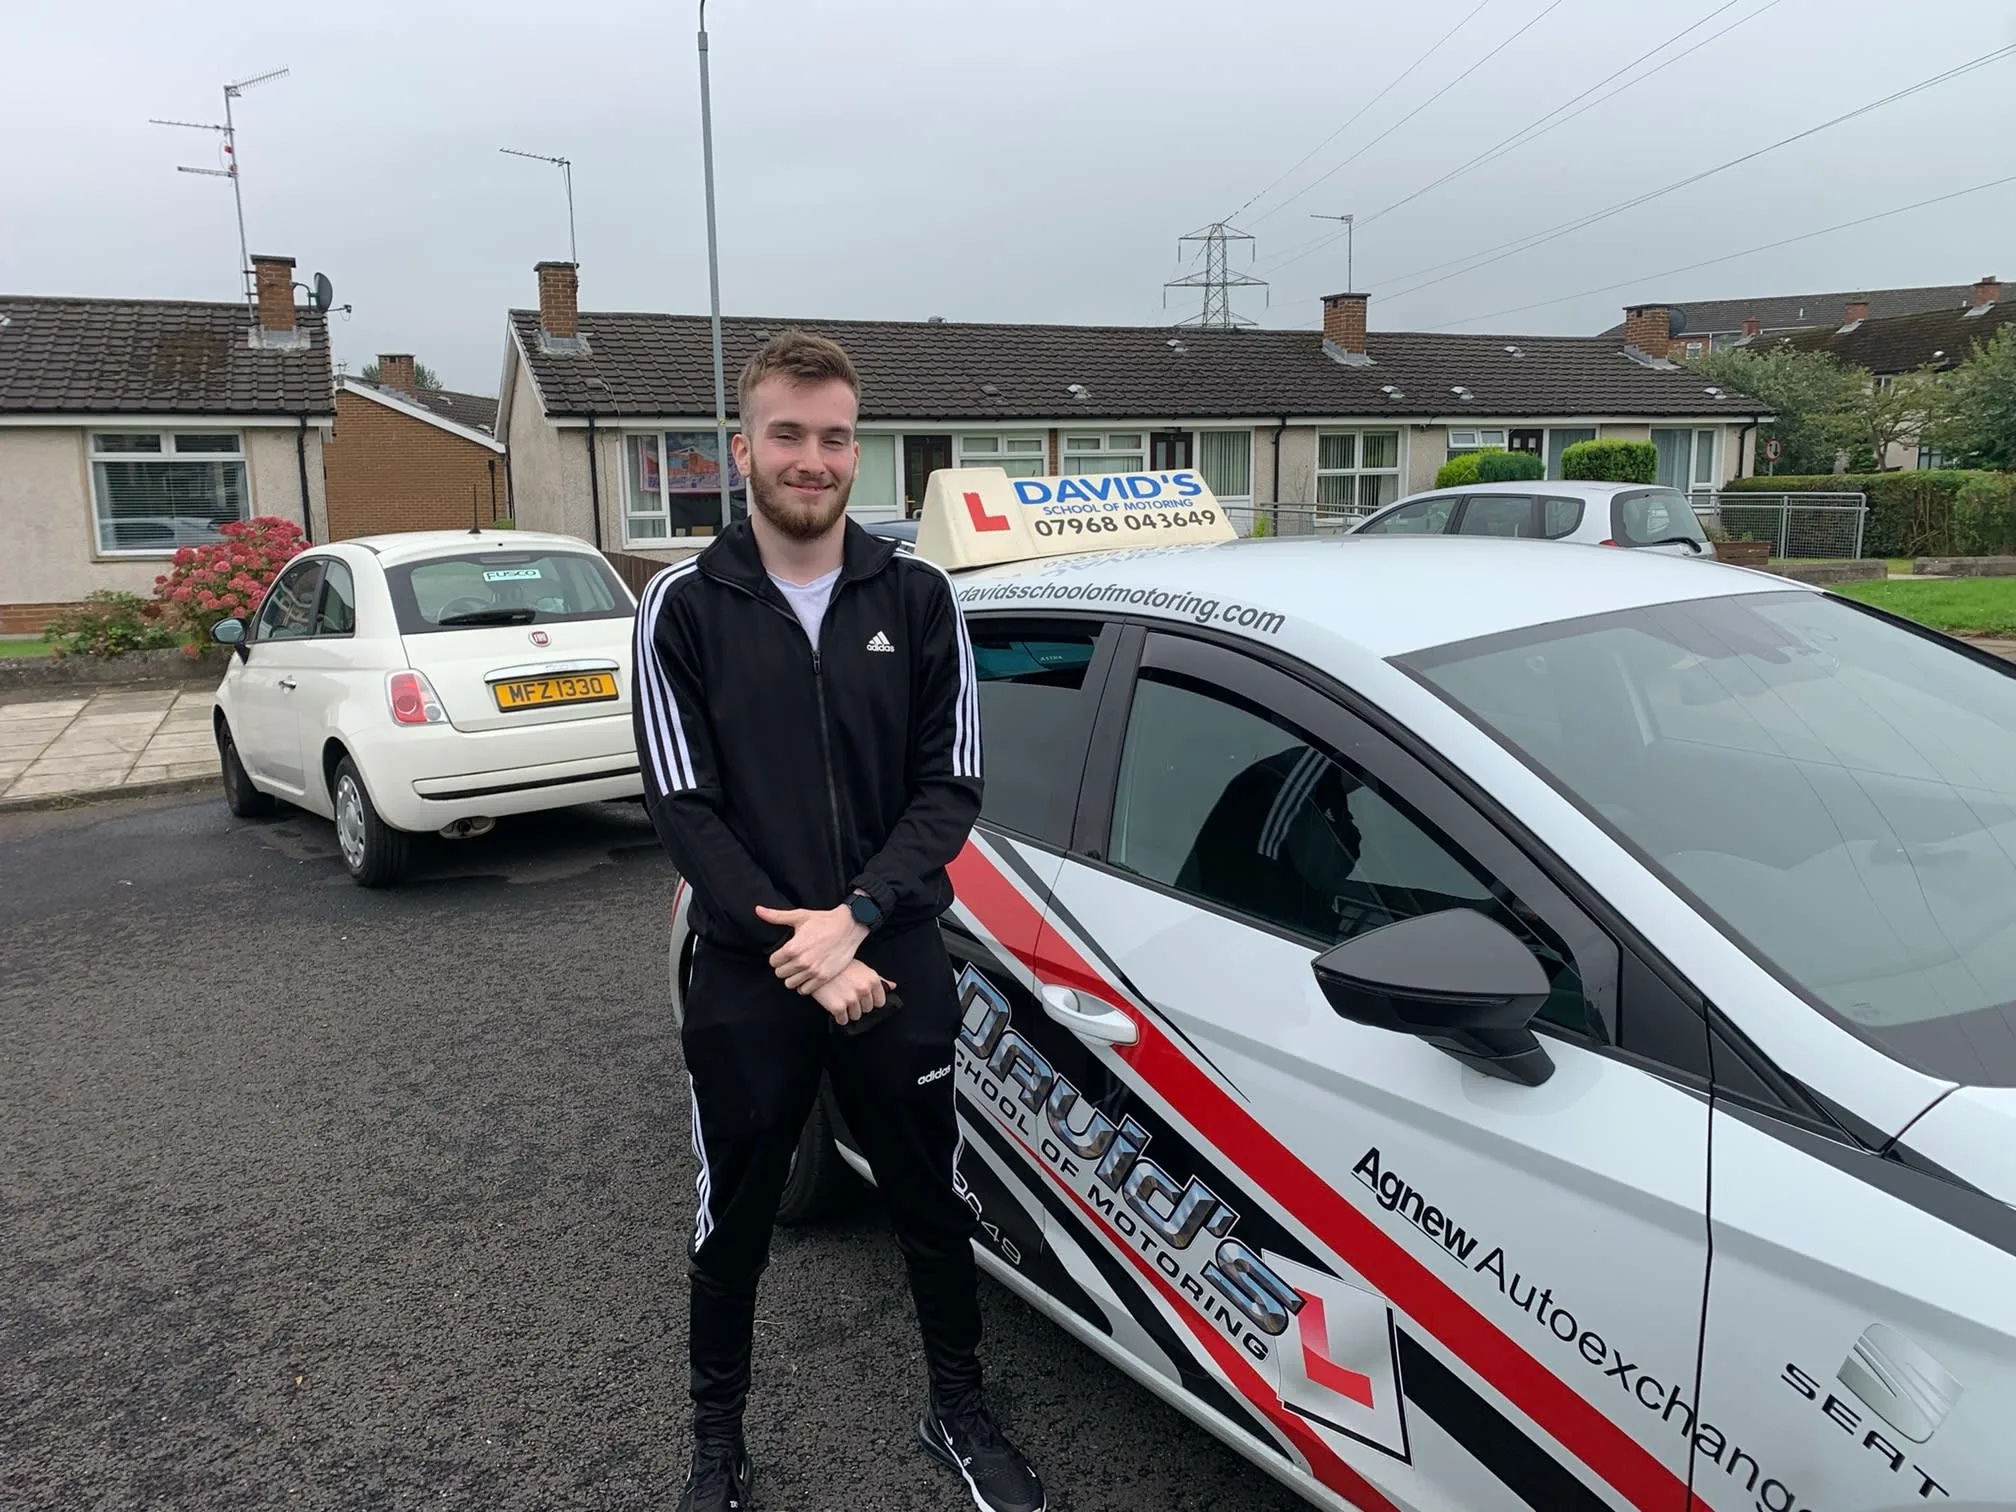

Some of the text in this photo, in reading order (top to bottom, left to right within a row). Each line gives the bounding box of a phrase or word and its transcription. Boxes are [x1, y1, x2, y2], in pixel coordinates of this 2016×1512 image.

[1013, 473, 1202, 505] DAVID'S
[1042, 498, 1194, 516] SCHOOL OF MOTORING
[1034, 509, 1216, 537] 07968 043649
[486, 570, 537, 580] FUSCO
[958, 582, 1286, 635] davidsschoolofmotoring.com
[866, 643, 895, 653] adidas
[917, 1064, 952, 1086] adidas
[956, 1048, 1270, 1362] HOOL OF MOTORING
[1351, 1147, 1813, 1512] Agnew Autoexchang
[1781, 1362, 1951, 1498] SEAT
